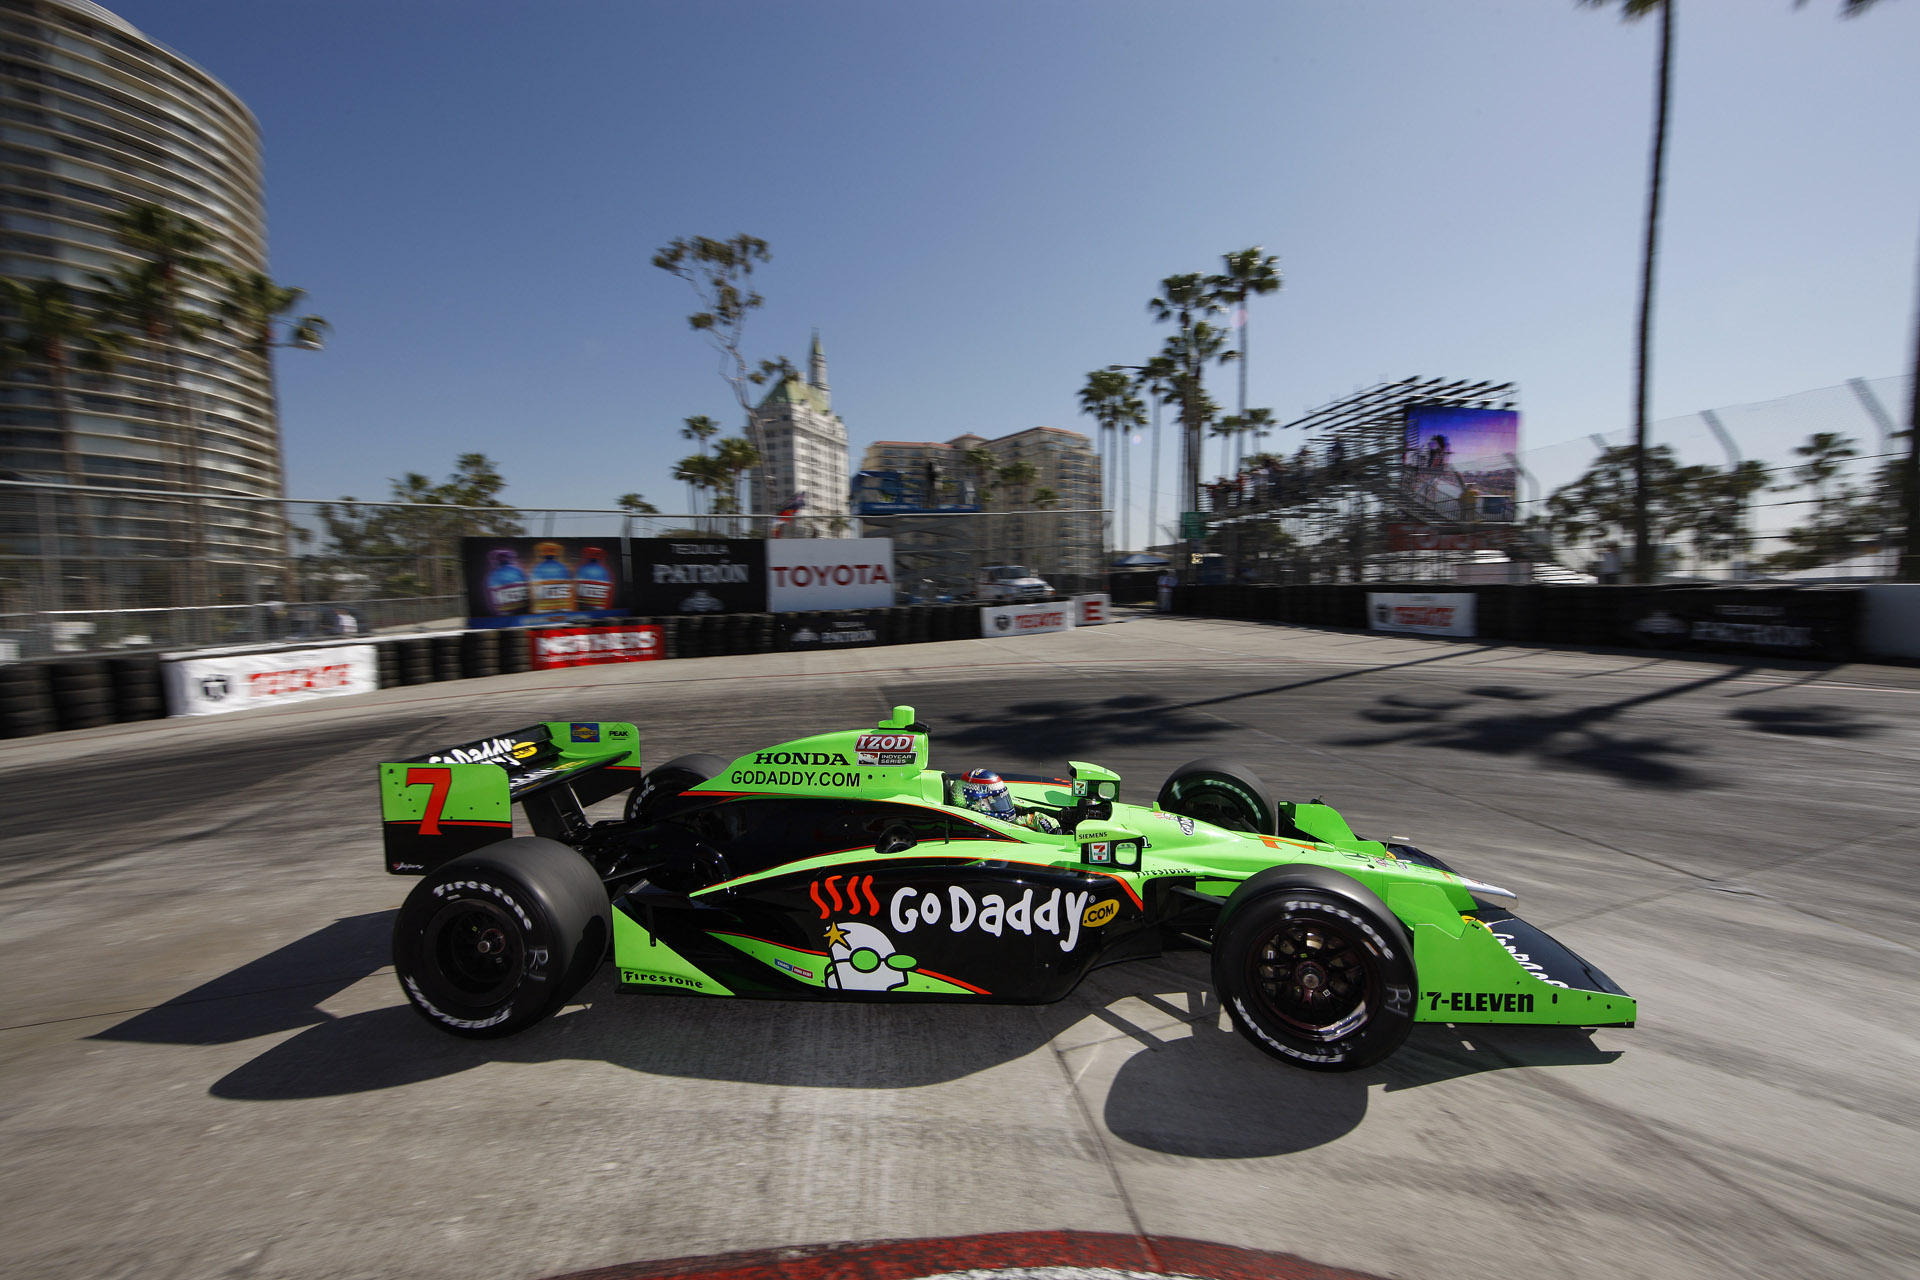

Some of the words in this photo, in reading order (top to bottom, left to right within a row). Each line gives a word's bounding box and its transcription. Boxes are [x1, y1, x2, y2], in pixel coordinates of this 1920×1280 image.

[670, 543, 729, 554] TEQUILA
[771, 564, 891, 587] TOYOTA
[857, 735, 911, 750] IZOD
[753, 752, 851, 766] HONDA
[731, 770, 861, 788] GODADDY.COM
[406, 768, 452, 835] 7
[1078, 831, 1108, 839] SIEMENS
[432, 880, 533, 932] Firestone
[890, 886, 940, 933] Go
[1284, 900, 1394, 961] Firestone
[623, 971, 704, 988] Firestone
